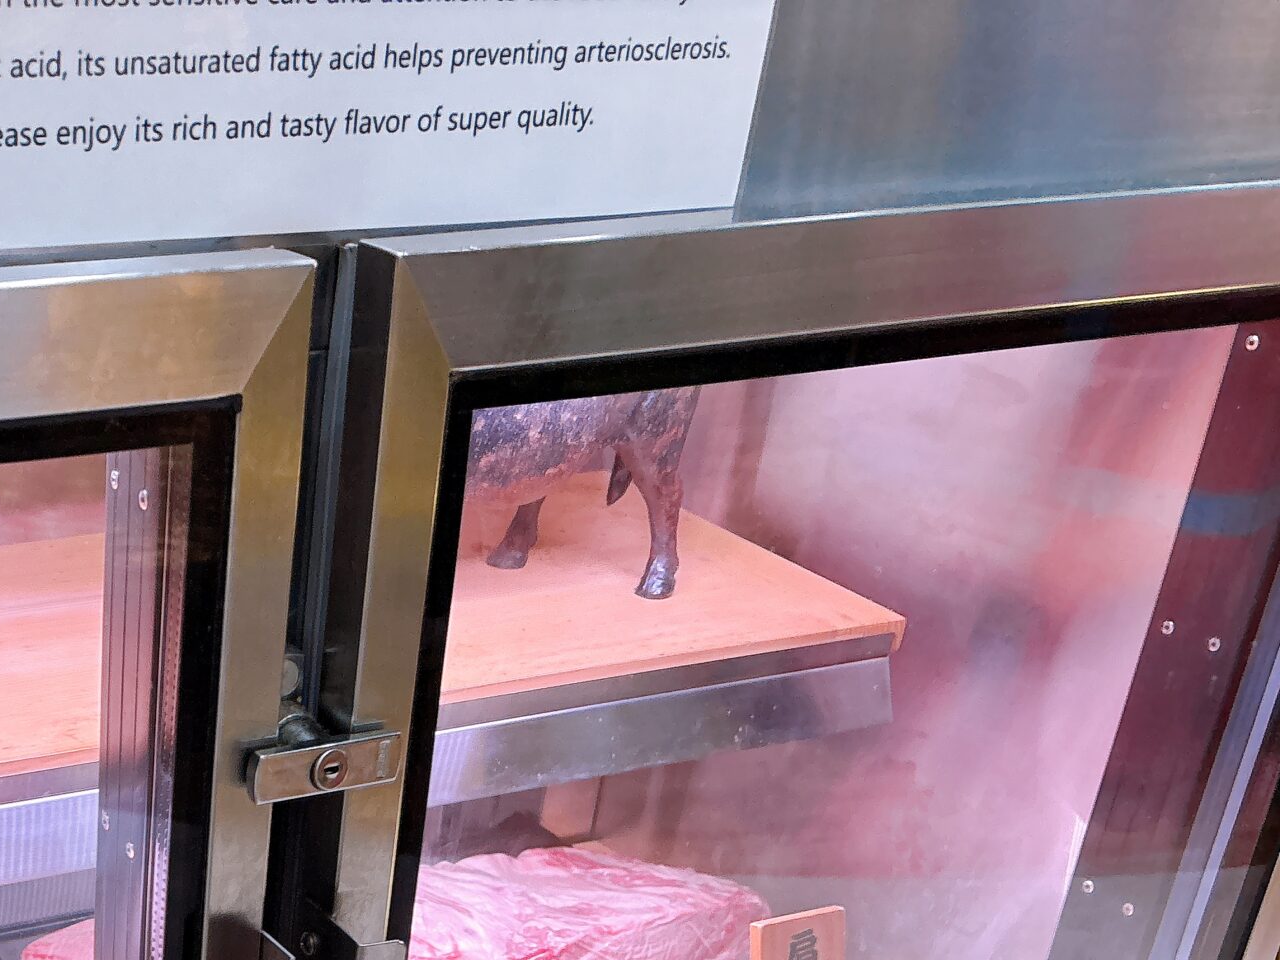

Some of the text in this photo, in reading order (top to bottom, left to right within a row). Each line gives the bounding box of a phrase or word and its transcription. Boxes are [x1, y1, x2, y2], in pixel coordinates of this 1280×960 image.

[9, 49, 68, 82] acid,
[77, 49, 106, 77] its
[114, 45, 261, 77] unsaturated
[268, 44, 323, 79] fatty
[328, 42, 377, 71] acid
[383, 41, 444, 76] helps
[449, 38, 569, 75] preventing
[574, 34, 731, 64] arteriosclerosis.
[56, 116, 128, 153] enjoy
[135, 115, 164, 143] its
[172, 113, 218, 142] rich
[225, 111, 273, 140] and
[279, 113, 338, 145] tasty
[344, 108, 412, 136] flavor
[417, 104, 444, 133] of
[447, 110, 512, 138] super
[516, 100, 594, 136] quality.
